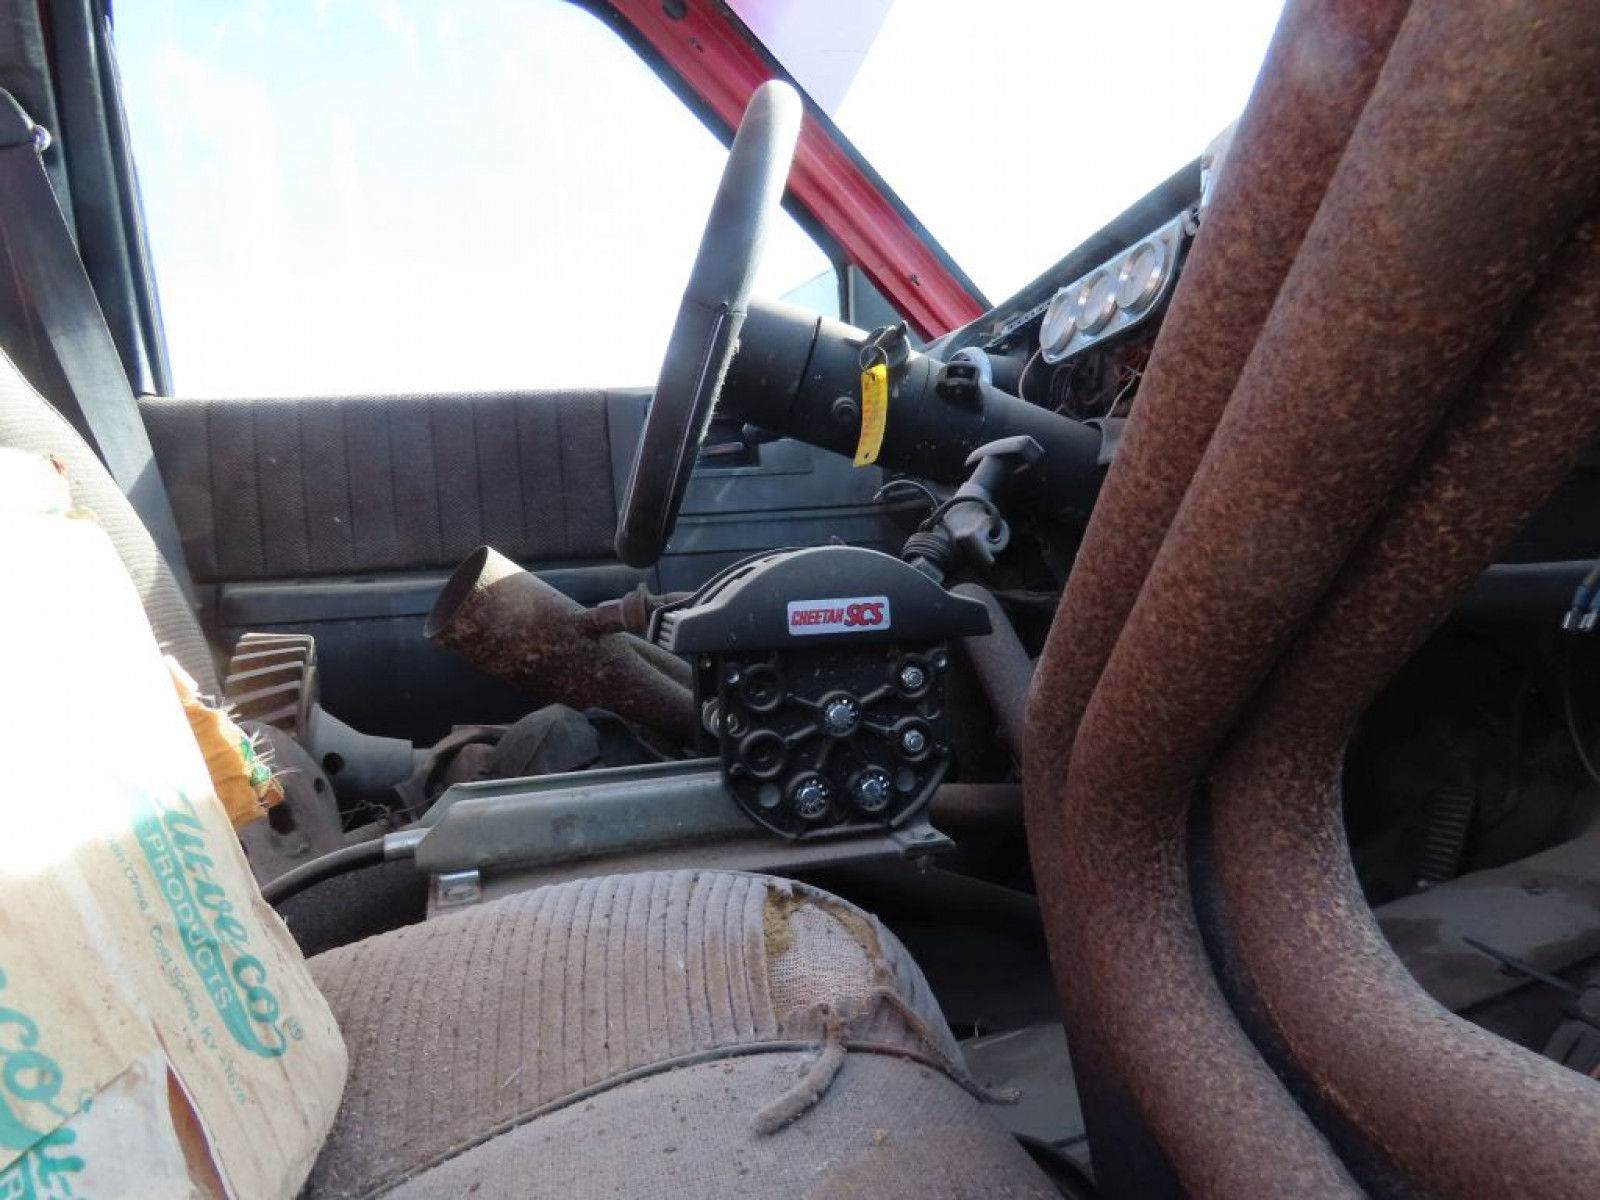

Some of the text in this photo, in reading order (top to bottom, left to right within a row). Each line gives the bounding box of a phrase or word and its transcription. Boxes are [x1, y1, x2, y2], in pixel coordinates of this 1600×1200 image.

[792, 603, 884, 627] CHEETAH SCS
[146, 832, 233, 1009] PRODUCTS
[150, 924, 172, 966] Cold
